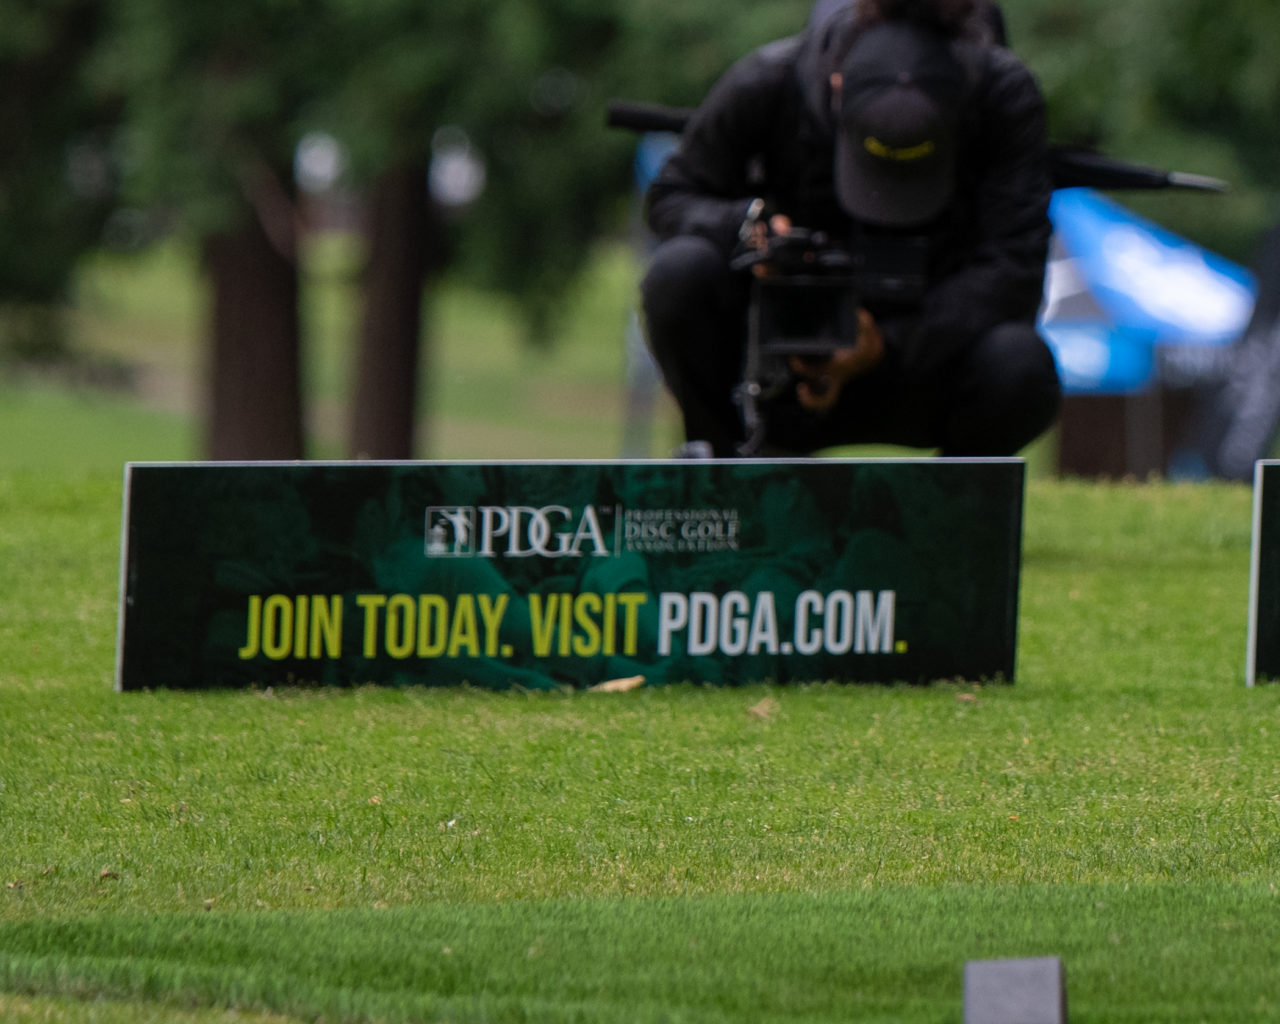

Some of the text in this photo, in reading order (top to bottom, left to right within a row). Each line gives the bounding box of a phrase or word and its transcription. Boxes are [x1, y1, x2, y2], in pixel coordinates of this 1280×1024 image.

[477, 504, 611, 557] PDGA
[624, 520, 740, 541] DISC GOLF
[238, 589, 909, 660] JOIN TODAY. VISIT PDGA.COM.
